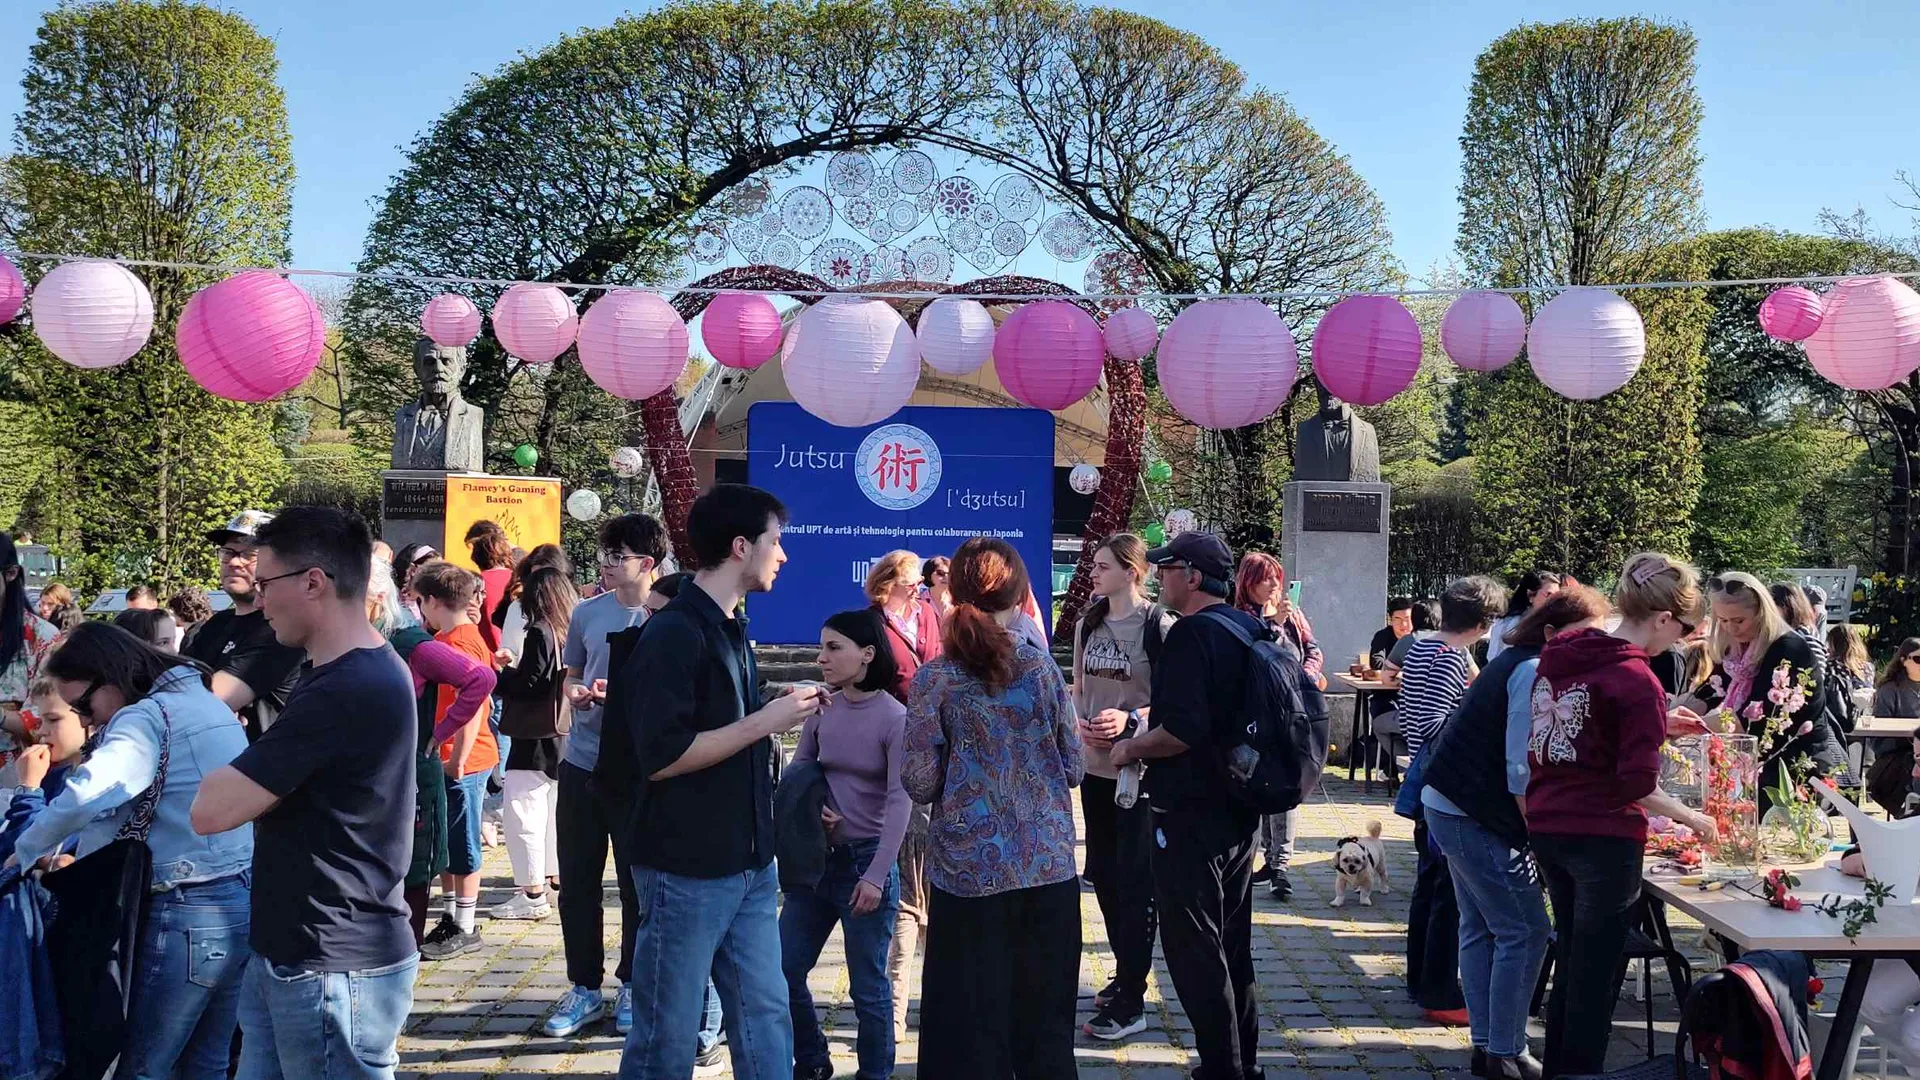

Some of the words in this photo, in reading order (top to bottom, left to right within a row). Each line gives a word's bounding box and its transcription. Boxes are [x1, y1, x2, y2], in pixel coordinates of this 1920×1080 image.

[774, 444, 844, 469] Jutsu
[871, 442, 926, 492] 術
[463, 484, 506, 493] Flamey's
[508, 485, 546, 495] Gaming
[486, 495, 523, 504] Bastion
[806, 525, 822, 534] UPT
[823, 526, 834, 534] de
[835, 526, 852, 535] artă
[861, 526, 905, 538] tehnologie
[906, 528, 933, 537] pentru
[934, 528, 981, 537] colaborarea
[983, 529, 992, 537] cu
[993, 528, 1024, 539] Japonia
